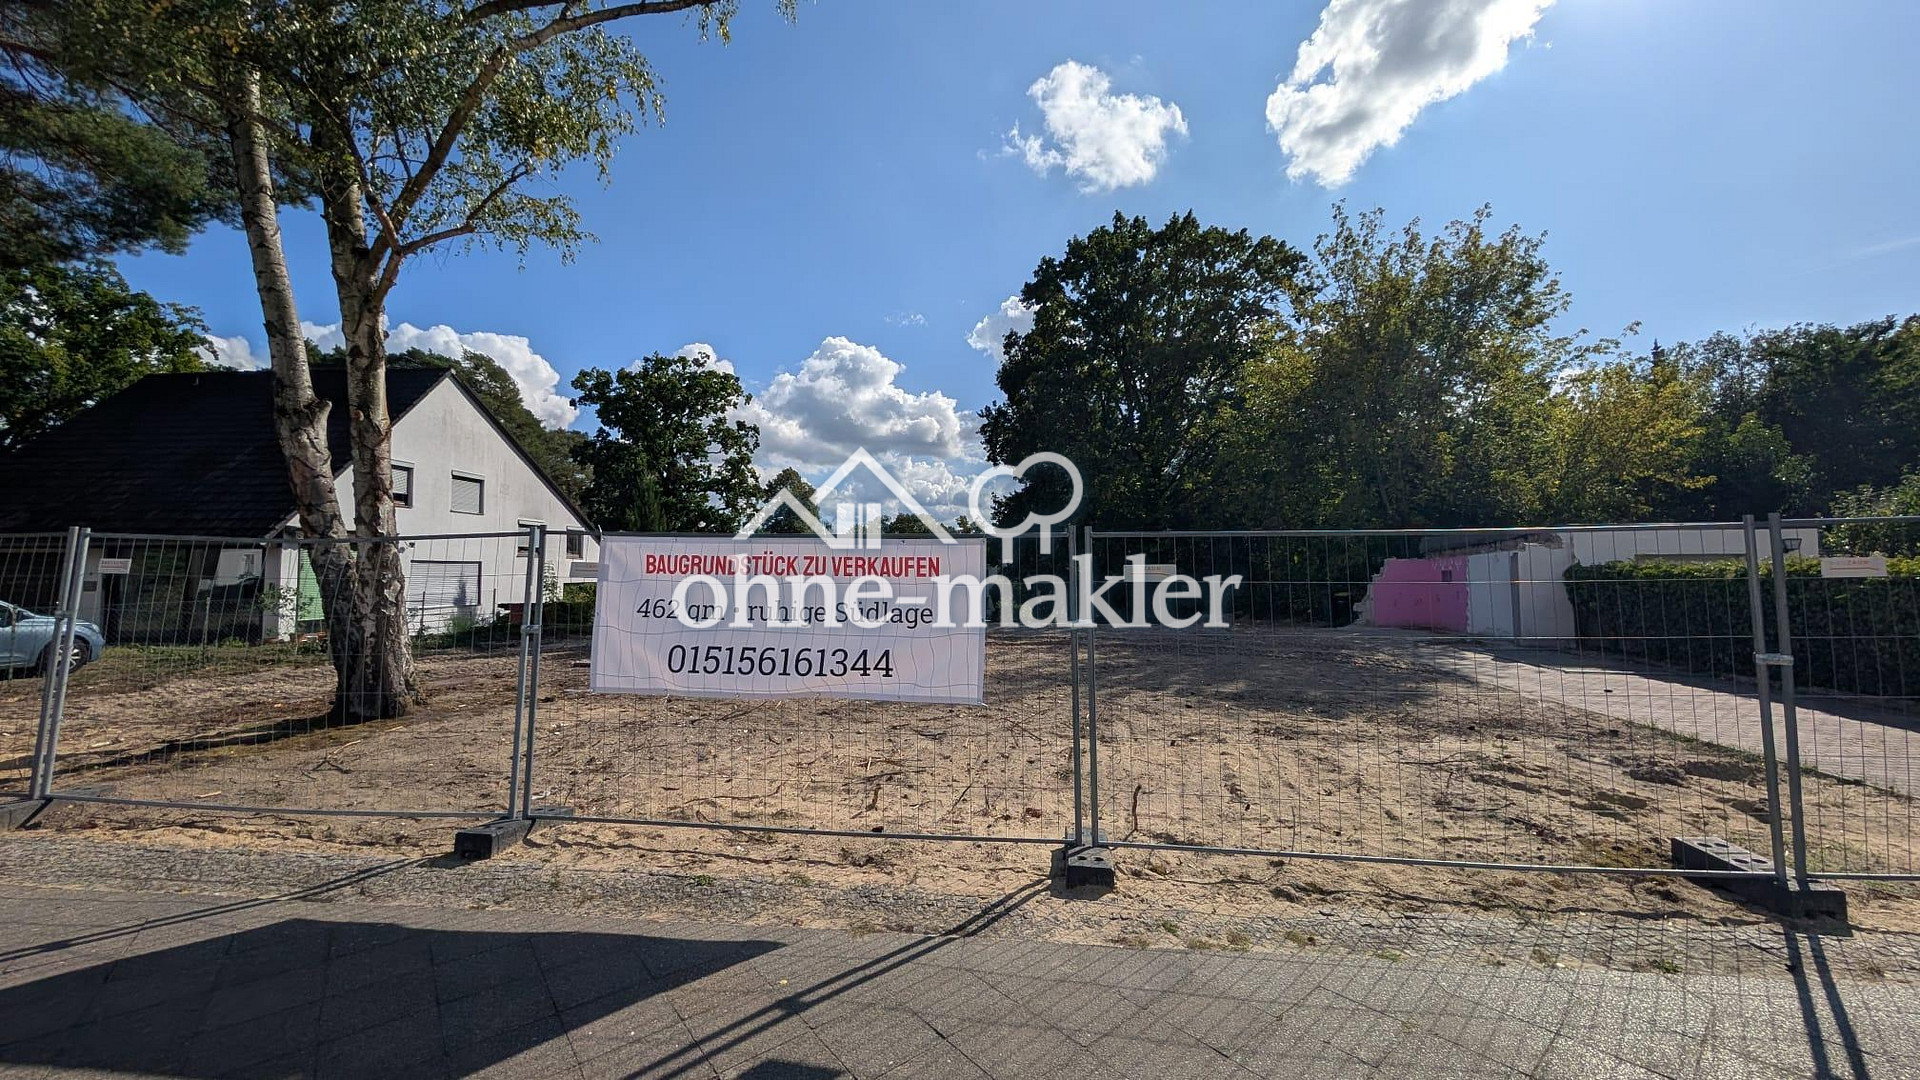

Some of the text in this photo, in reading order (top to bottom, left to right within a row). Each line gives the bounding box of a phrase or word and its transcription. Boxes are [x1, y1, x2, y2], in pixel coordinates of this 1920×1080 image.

[646, 551, 940, 578] BAUGRUNDSTÜCK ZU VERKAUFEN
[637, 598, 680, 619] 462
[688, 603, 725, 625] qm
[747, 600, 826, 628] ruhige
[836, 601, 933, 630] Südlage
[667, 644, 894, 678] 015156161344
